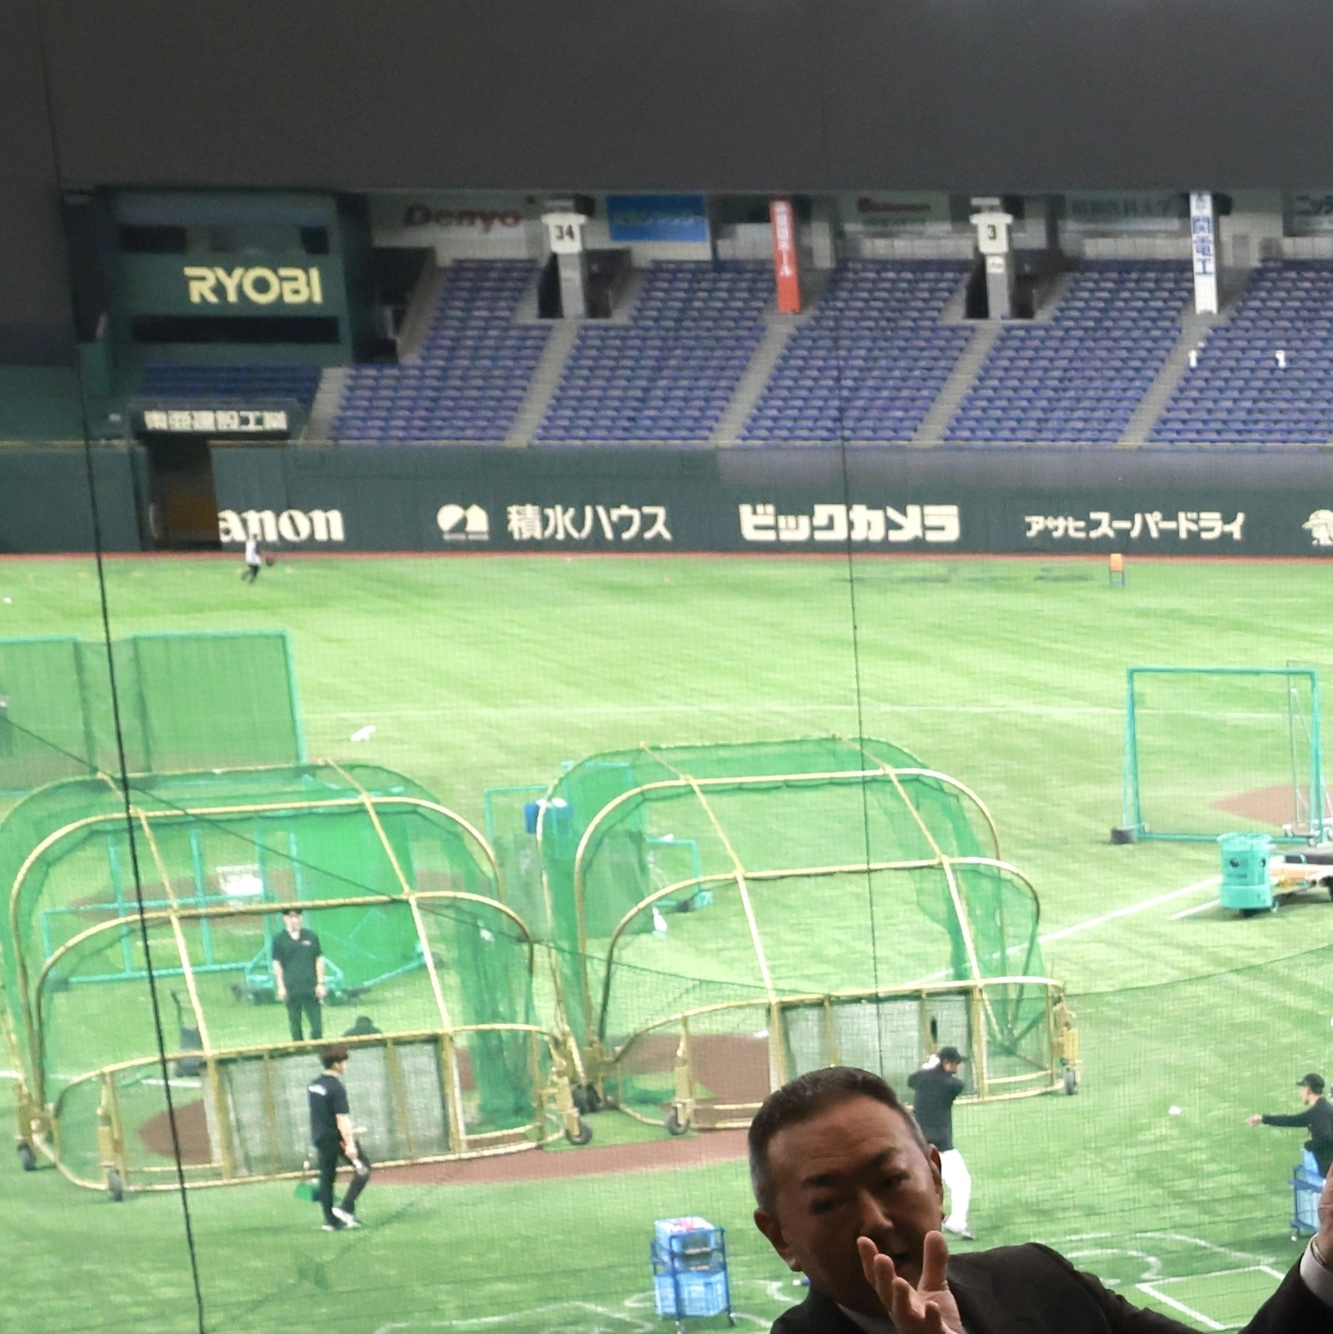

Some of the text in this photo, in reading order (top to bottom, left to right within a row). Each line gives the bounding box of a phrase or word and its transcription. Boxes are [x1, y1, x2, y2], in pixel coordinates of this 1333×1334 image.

[403, 203, 523, 232] Denyo
[553, 223, 577, 242] 34
[985, 223, 997, 241] 3
[183, 266, 322, 304] RYOBI
[217, 508, 346, 543] anon
[507, 505, 672, 540] 積水ハウス
[739, 504, 960, 543] ビックカメラ
[1025, 512, 1246, 541] アサヒスーパードライ
